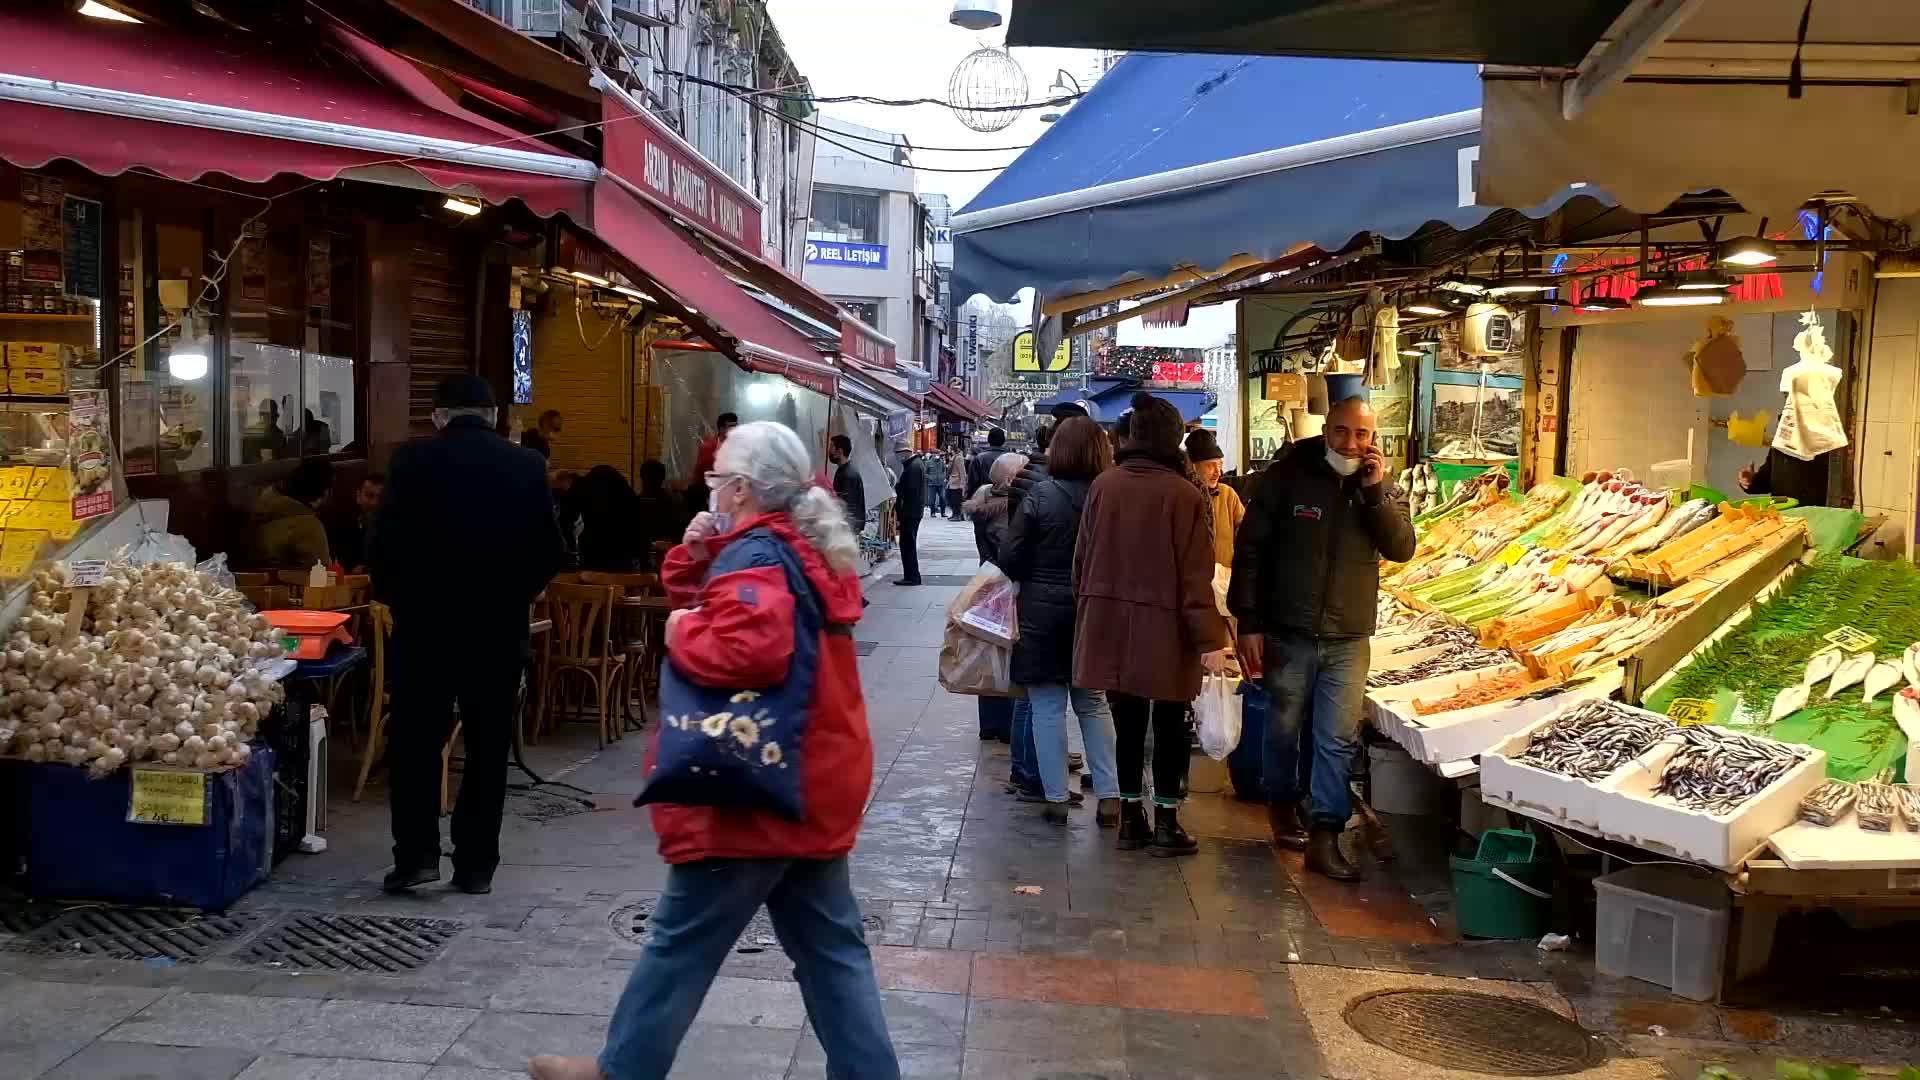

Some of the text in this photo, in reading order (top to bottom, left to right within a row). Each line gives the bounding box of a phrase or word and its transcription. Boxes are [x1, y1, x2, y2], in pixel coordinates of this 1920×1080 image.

[643, 139, 670, 198] ARZUM
[820, 246, 881, 265] REEL İLETİŞİM
[968, 357, 977, 371] LC
